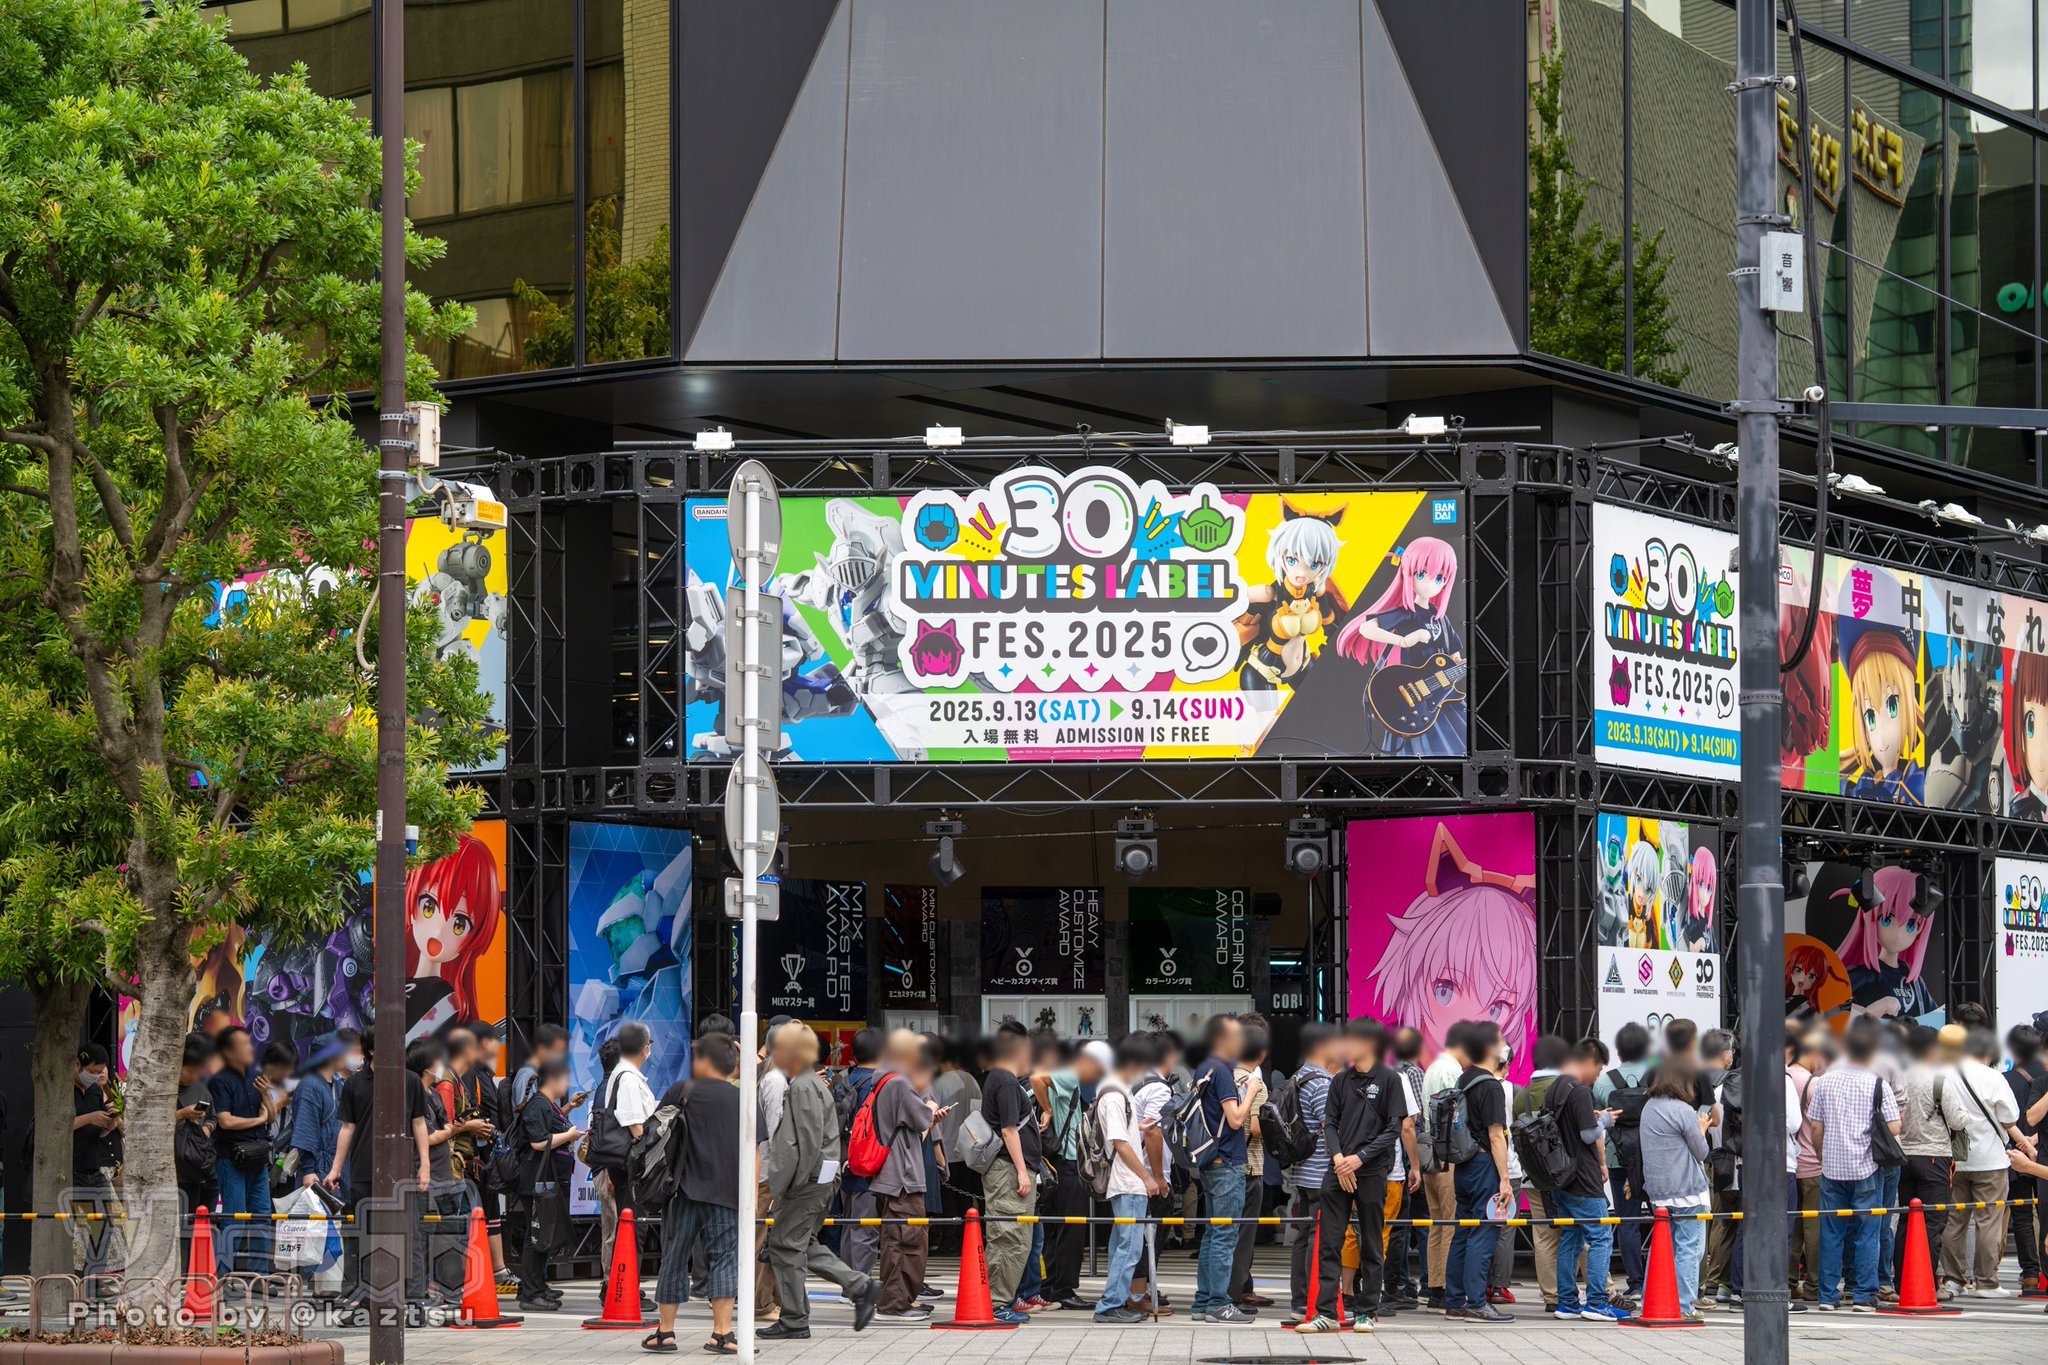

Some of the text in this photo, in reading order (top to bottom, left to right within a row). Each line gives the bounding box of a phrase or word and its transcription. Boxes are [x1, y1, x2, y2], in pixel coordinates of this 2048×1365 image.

[1002, 474, 1139, 559] 30
[1434, 503, 1455, 512] BAN
[1434, 511, 1451, 520] DAI
[905, 563, 1235, 600] MINUTES LABEL
[1645, 537, 1698, 616] 30
[971, 620, 1172, 660] FES.2025
[1606, 606, 1736, 660] MINUTES LABEL
[1634, 661, 1713, 706] FES.2025
[929, 697, 1245, 723] 2025.9.13(SAT) 9.14(SUN)
[963, 728, 1039, 744] 入場無料
[1055, 726, 1210, 743] ADMISSION IS FREE
[1607, 720, 1737, 761] 2025.9.13(SAT) 9.14(SUN)
[852, 885, 863, 940] MIX
[2020, 875, 2042, 911] 30
[1059, 889, 1070, 956] AWARD
[1073, 889, 1085, 990] CUSTOMIZE
[1088, 889, 1099, 949] HEAVY
[1215, 889, 1229, 965] AWARD
[1231, 890, 1245, 989] COLORING
[2003, 909, 2036, 928] MINUTES
[826, 883, 838, 998] AWARD
[839, 885, 851, 1013] MASTER
[929, 921, 937, 1003] CUSTOMIZE
[771, 997, 815, 1008] MIXマスター賞
[990, 977, 1058, 986] ヘビーカスタマイズ賞
[1145, 977, 1192, 986] カラーリング賞
